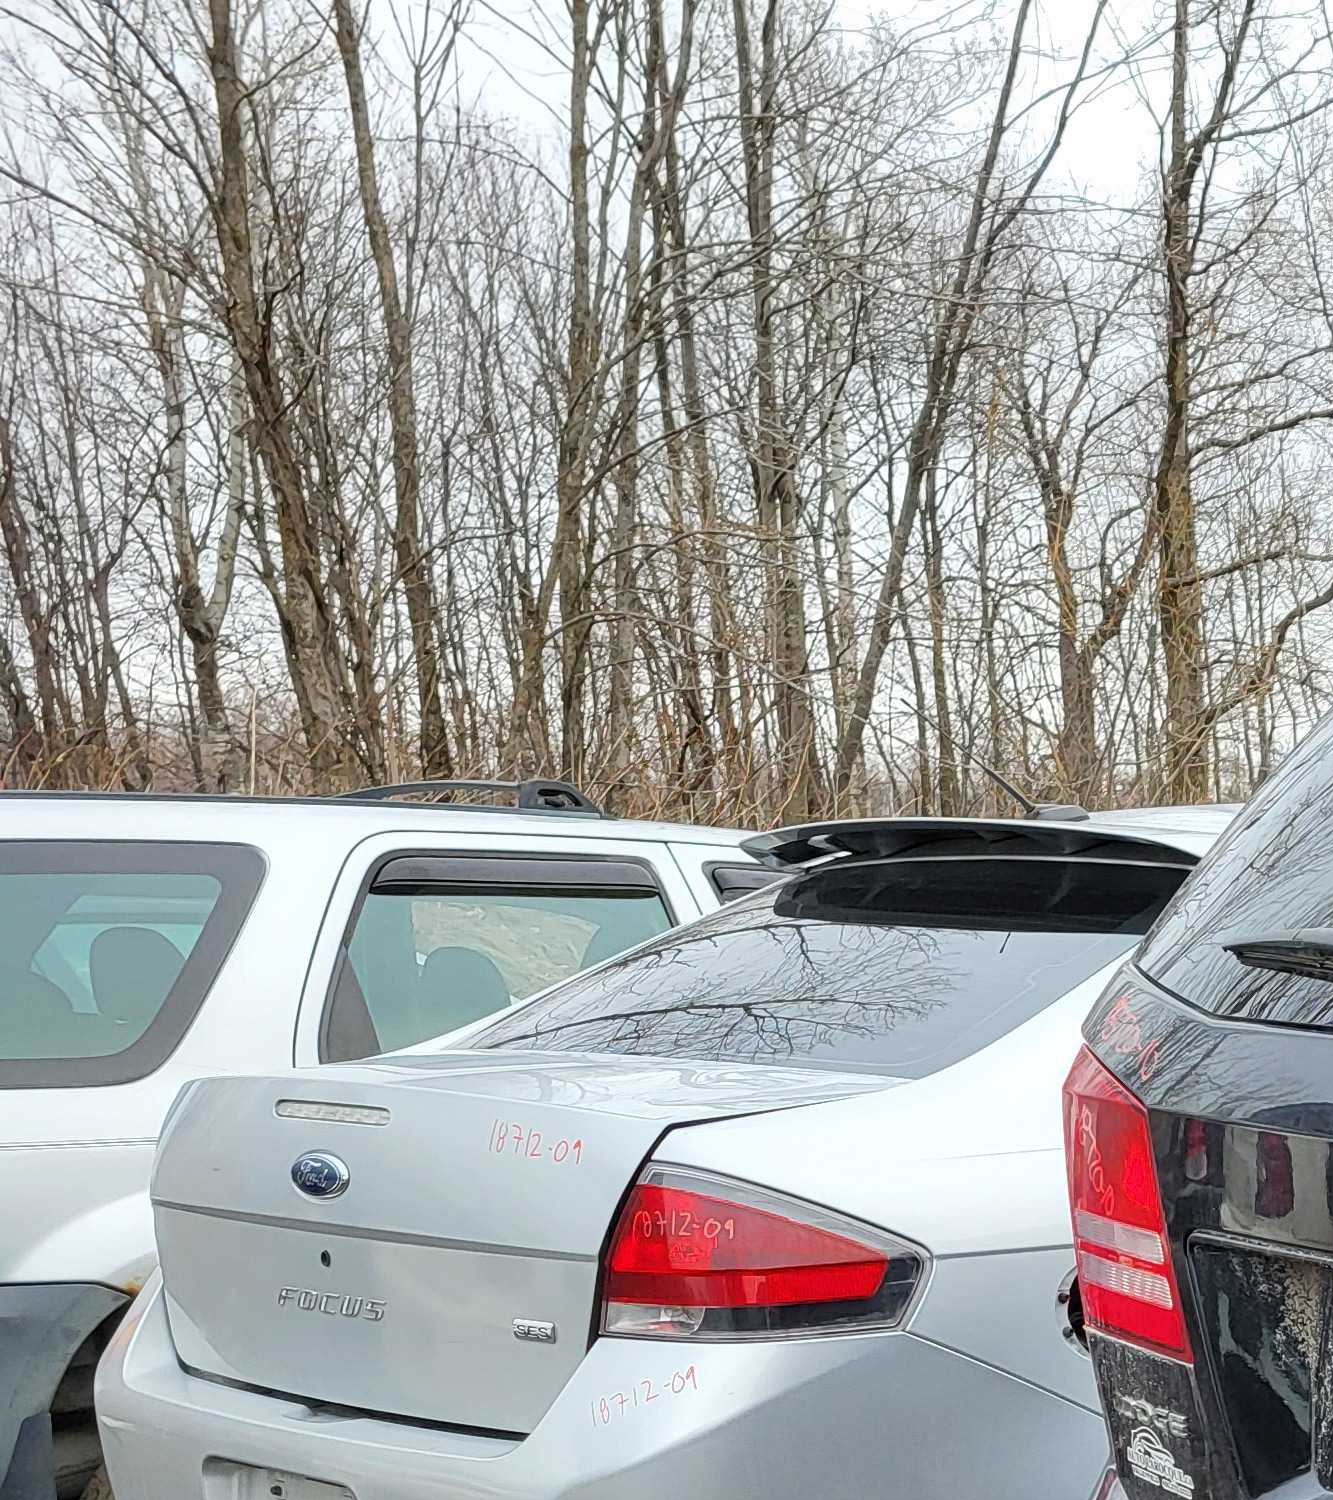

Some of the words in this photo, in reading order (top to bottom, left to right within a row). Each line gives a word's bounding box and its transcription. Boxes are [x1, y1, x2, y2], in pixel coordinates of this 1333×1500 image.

[489, 1118, 585, 1165] 18712-09
[632, 1210, 735, 1240] 18712-09
[277, 1286, 388, 1322] FOCUS
[515, 1321, 553, 1341] SES
[590, 1365, 699, 1427] 18712-09
